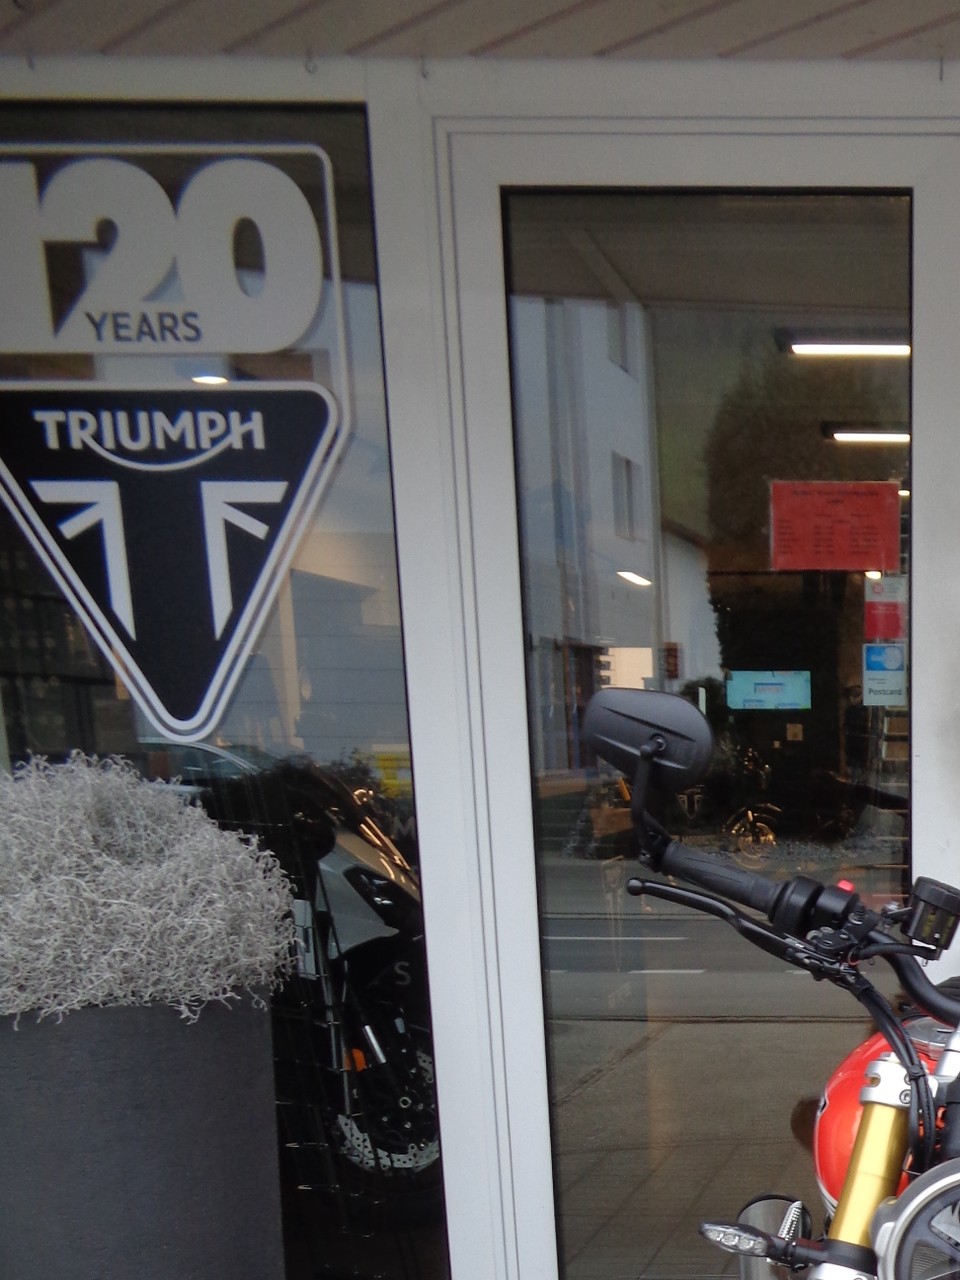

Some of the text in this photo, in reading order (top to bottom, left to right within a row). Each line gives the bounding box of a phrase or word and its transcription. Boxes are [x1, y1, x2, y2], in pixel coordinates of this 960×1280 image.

[85, 311, 203, 343] YEARS
[32, 410, 265, 471] TRIUMPH
[868, 688, 903, 697] Postcard
